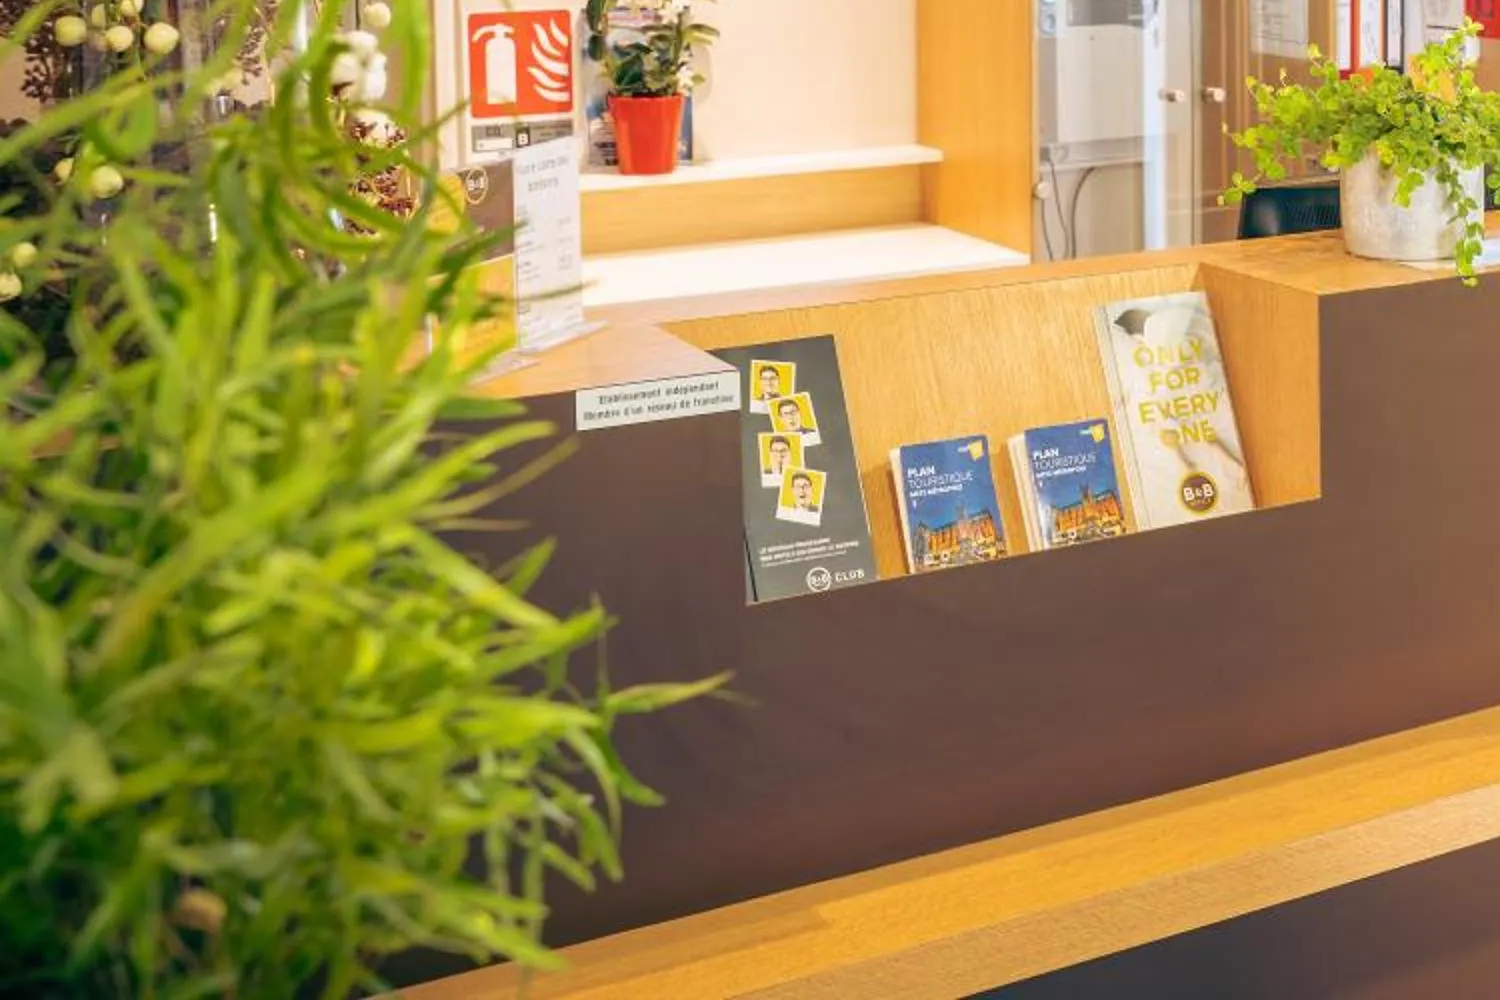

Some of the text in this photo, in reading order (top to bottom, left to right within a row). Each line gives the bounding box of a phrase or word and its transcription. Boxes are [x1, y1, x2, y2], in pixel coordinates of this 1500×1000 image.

[1133, 340, 1204, 369] ONLY
[1150, 367, 1201, 394] FOR
[1138, 391, 1219, 424] EVERY
[1159, 420, 1218, 448] ONE
[1033, 447, 1059, 461] PLAN
[1035, 451, 1097, 470] TOURISTIQUE
[907, 465, 935, 479] PLAN
[908, 470, 974, 489] TOURISTIQUE
[1183, 483, 1214, 501] B&B
[835, 568, 865, 583] CLUB
